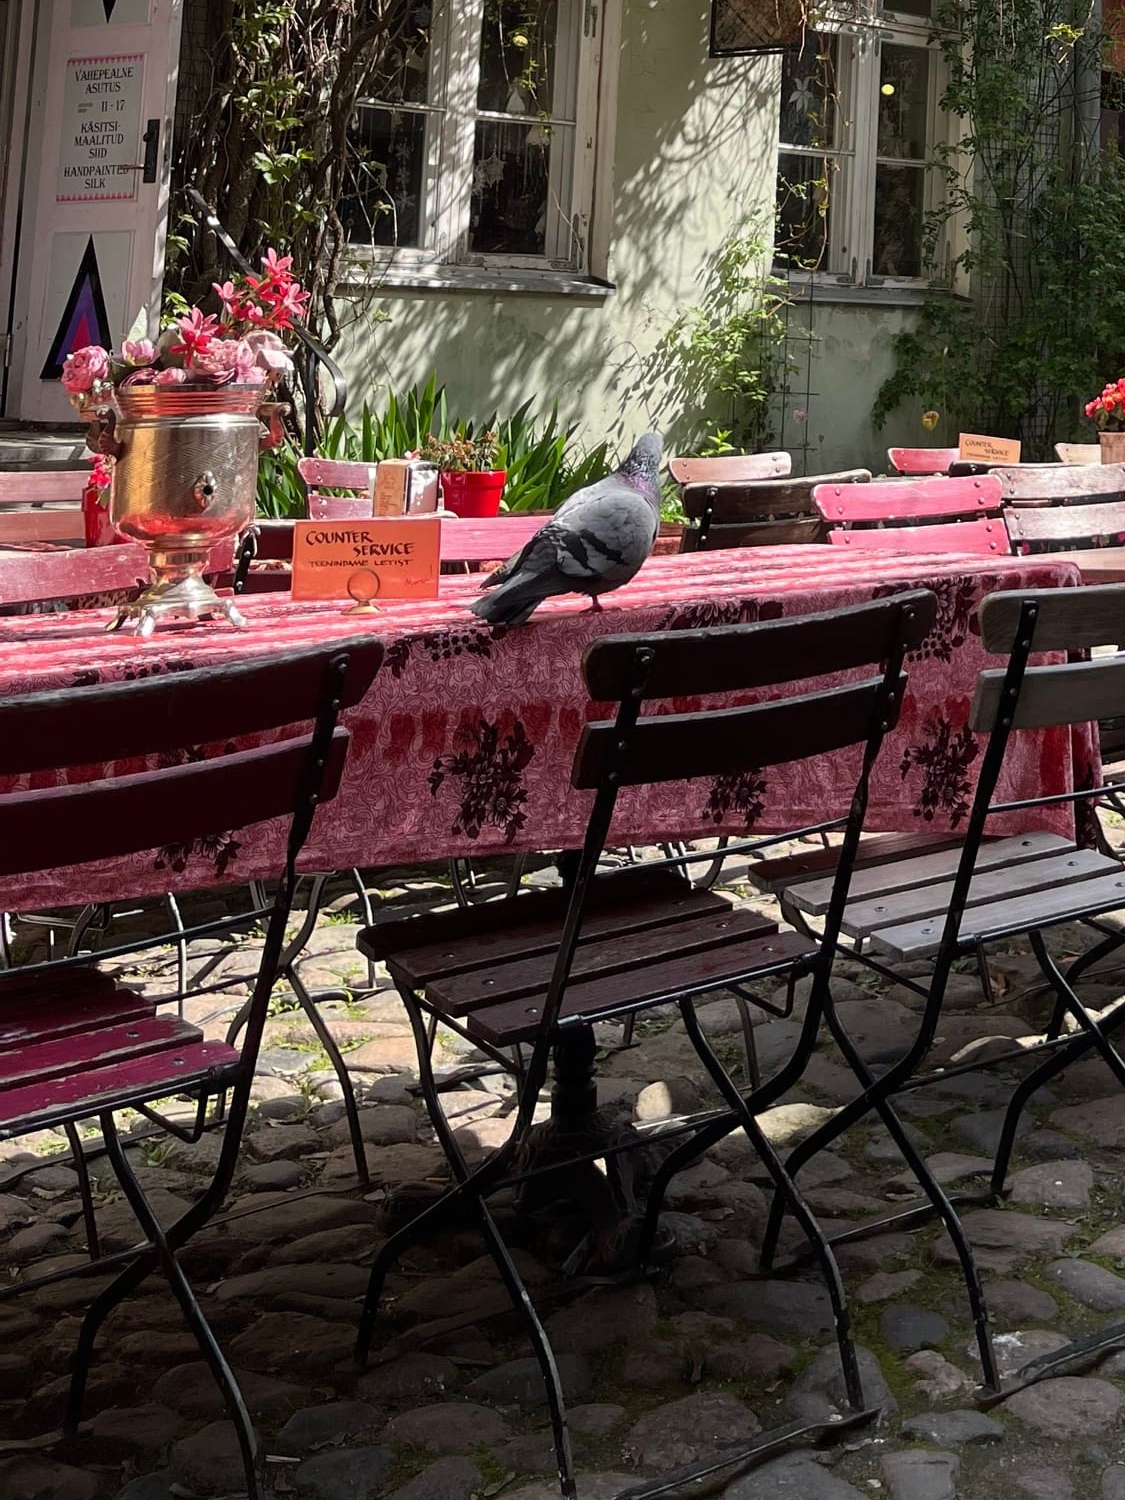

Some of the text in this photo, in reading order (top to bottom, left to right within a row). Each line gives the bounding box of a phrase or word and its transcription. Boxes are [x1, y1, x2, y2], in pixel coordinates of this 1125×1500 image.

[75, 67, 134, 81] VAHEPEALNE
[85, 82, 121, 94] ASUTUS
[80, 121, 121, 134] KÄSITSI-
[74, 134, 124, 146] MAALITUD
[88, 148, 107, 159] SIID
[63, 164, 129, 177] HANDPAINTED
[84, 179, 105, 189] SILK
[305, 530, 374, 546] COUNTER
[353, 542, 415, 557] SERVICE
